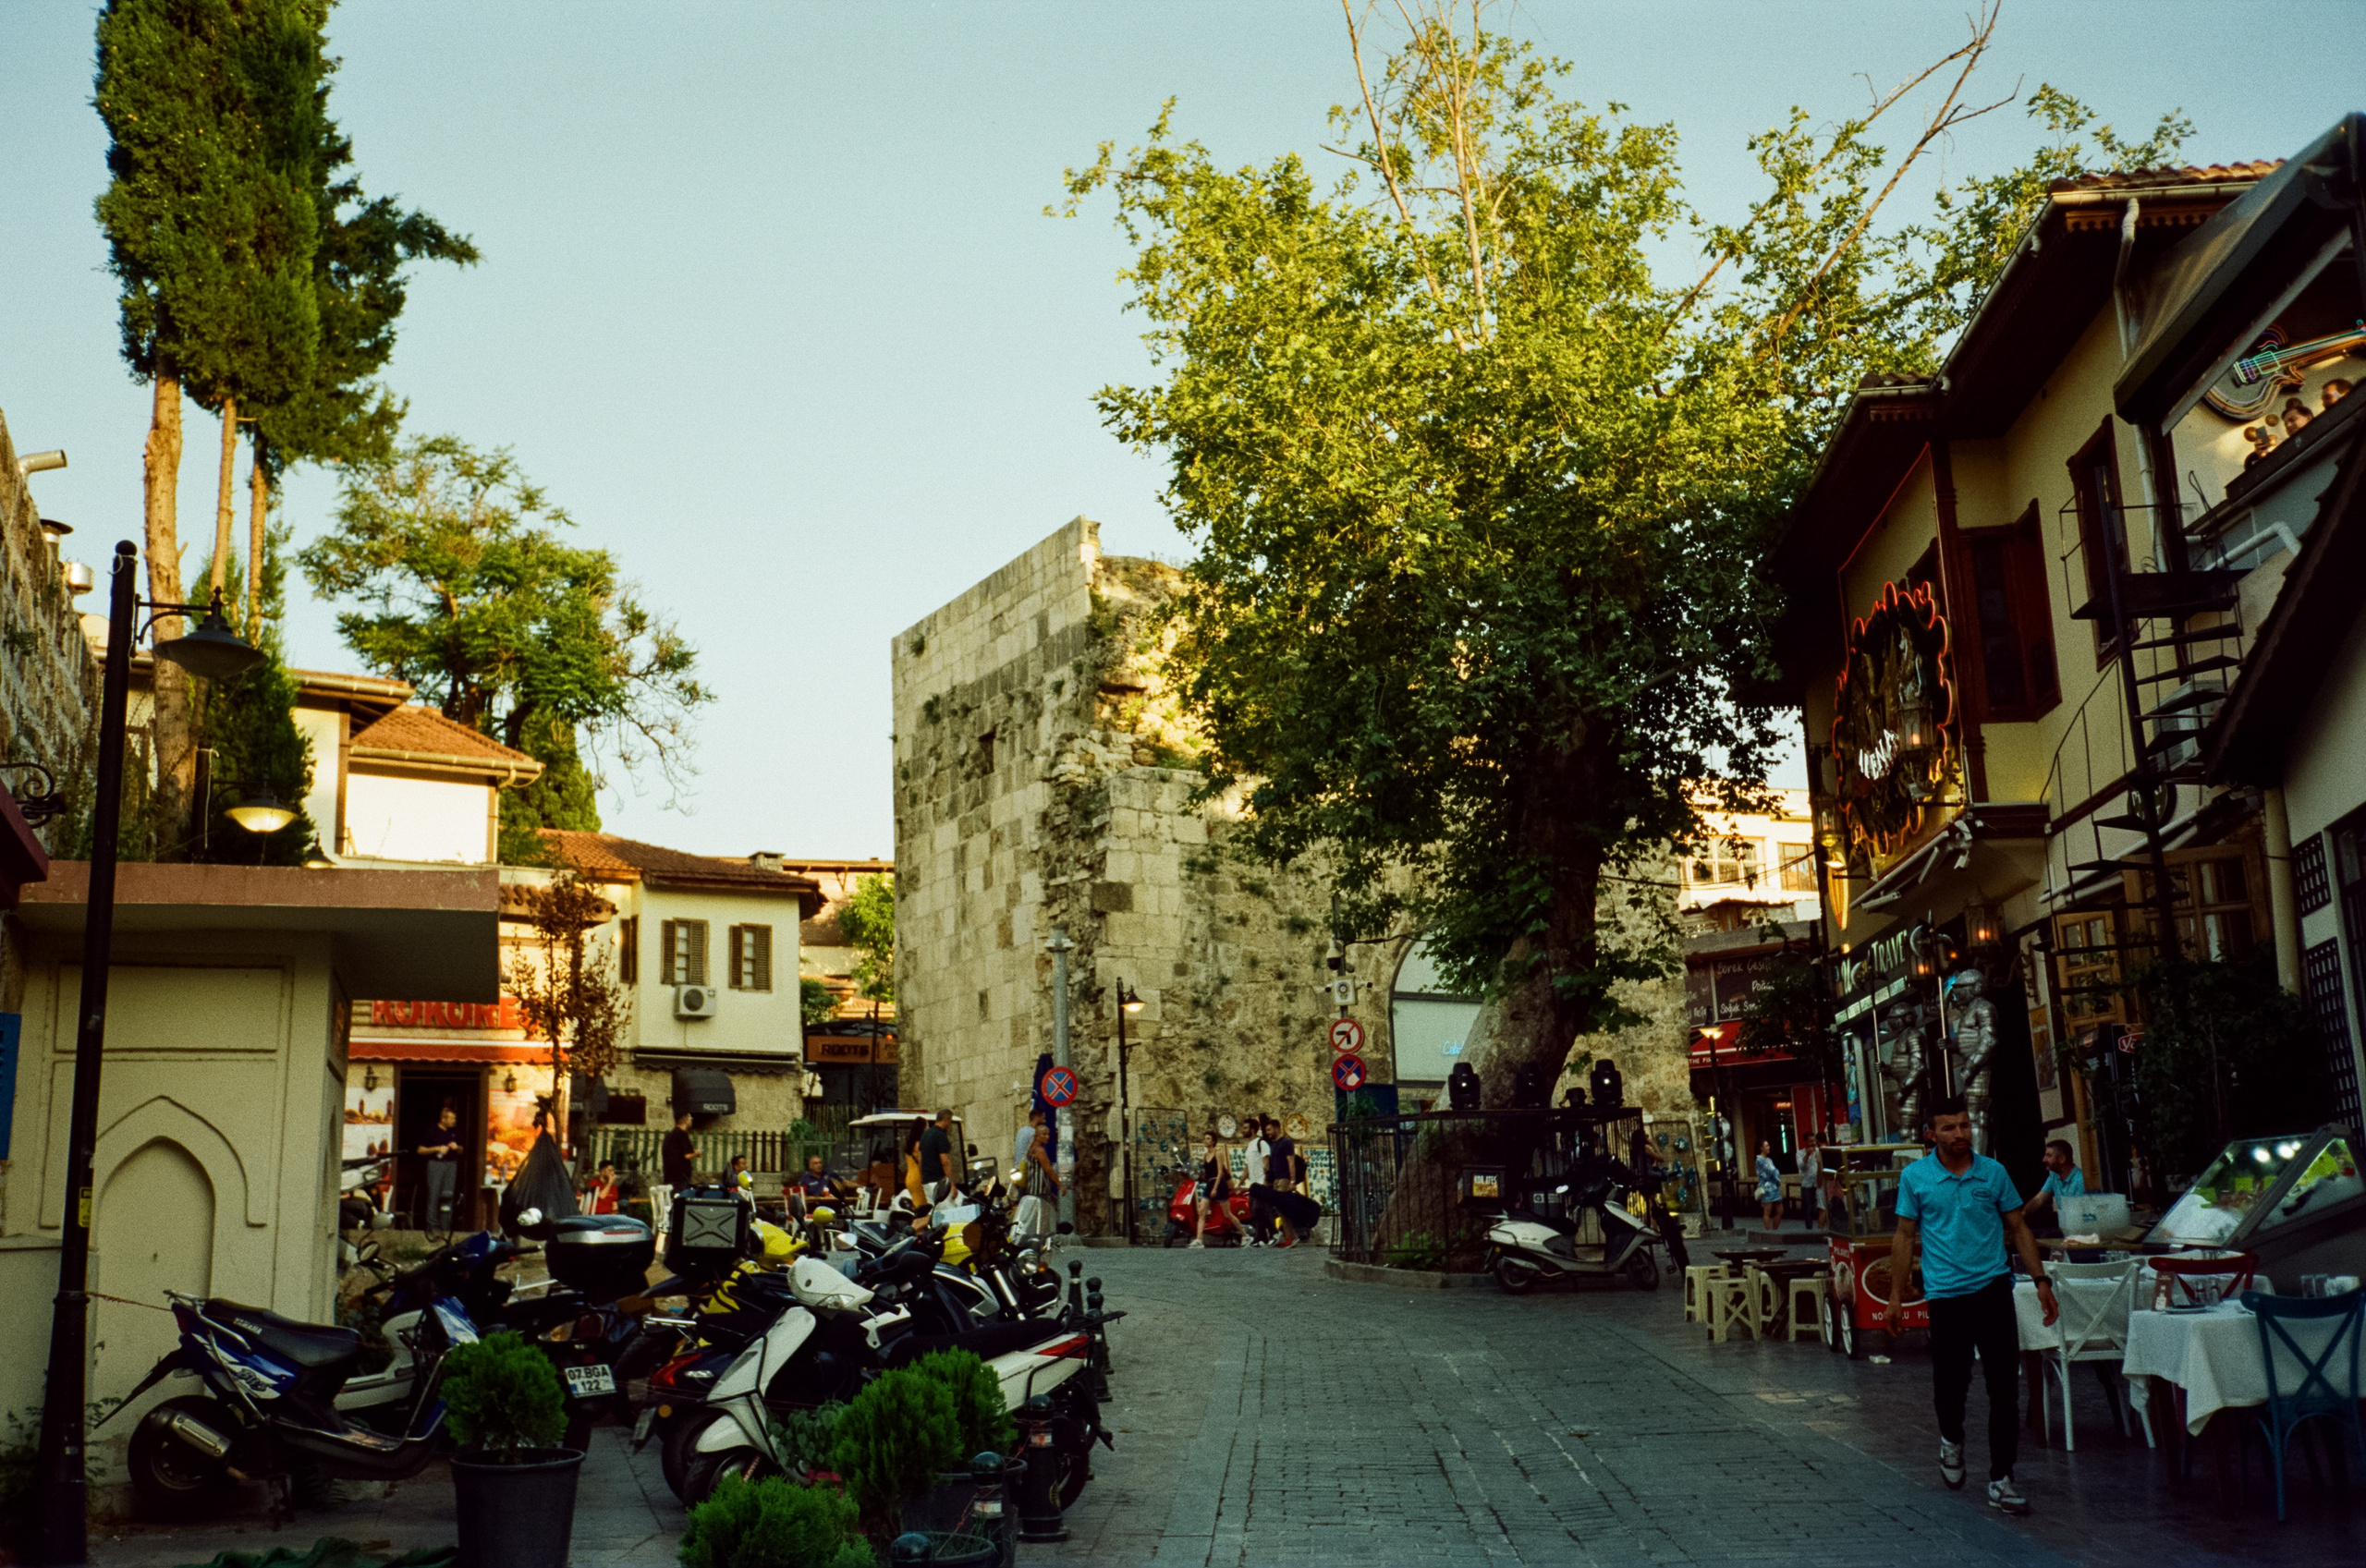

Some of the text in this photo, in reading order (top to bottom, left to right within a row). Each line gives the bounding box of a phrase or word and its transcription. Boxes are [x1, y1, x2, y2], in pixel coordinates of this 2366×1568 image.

[822, 1044, 869, 1055] ROOTS
[703, 1103, 728, 1112] ROOTS
[569, 1367, 608, 1380] 07 BGA
[581, 1380, 601, 1391] 122
